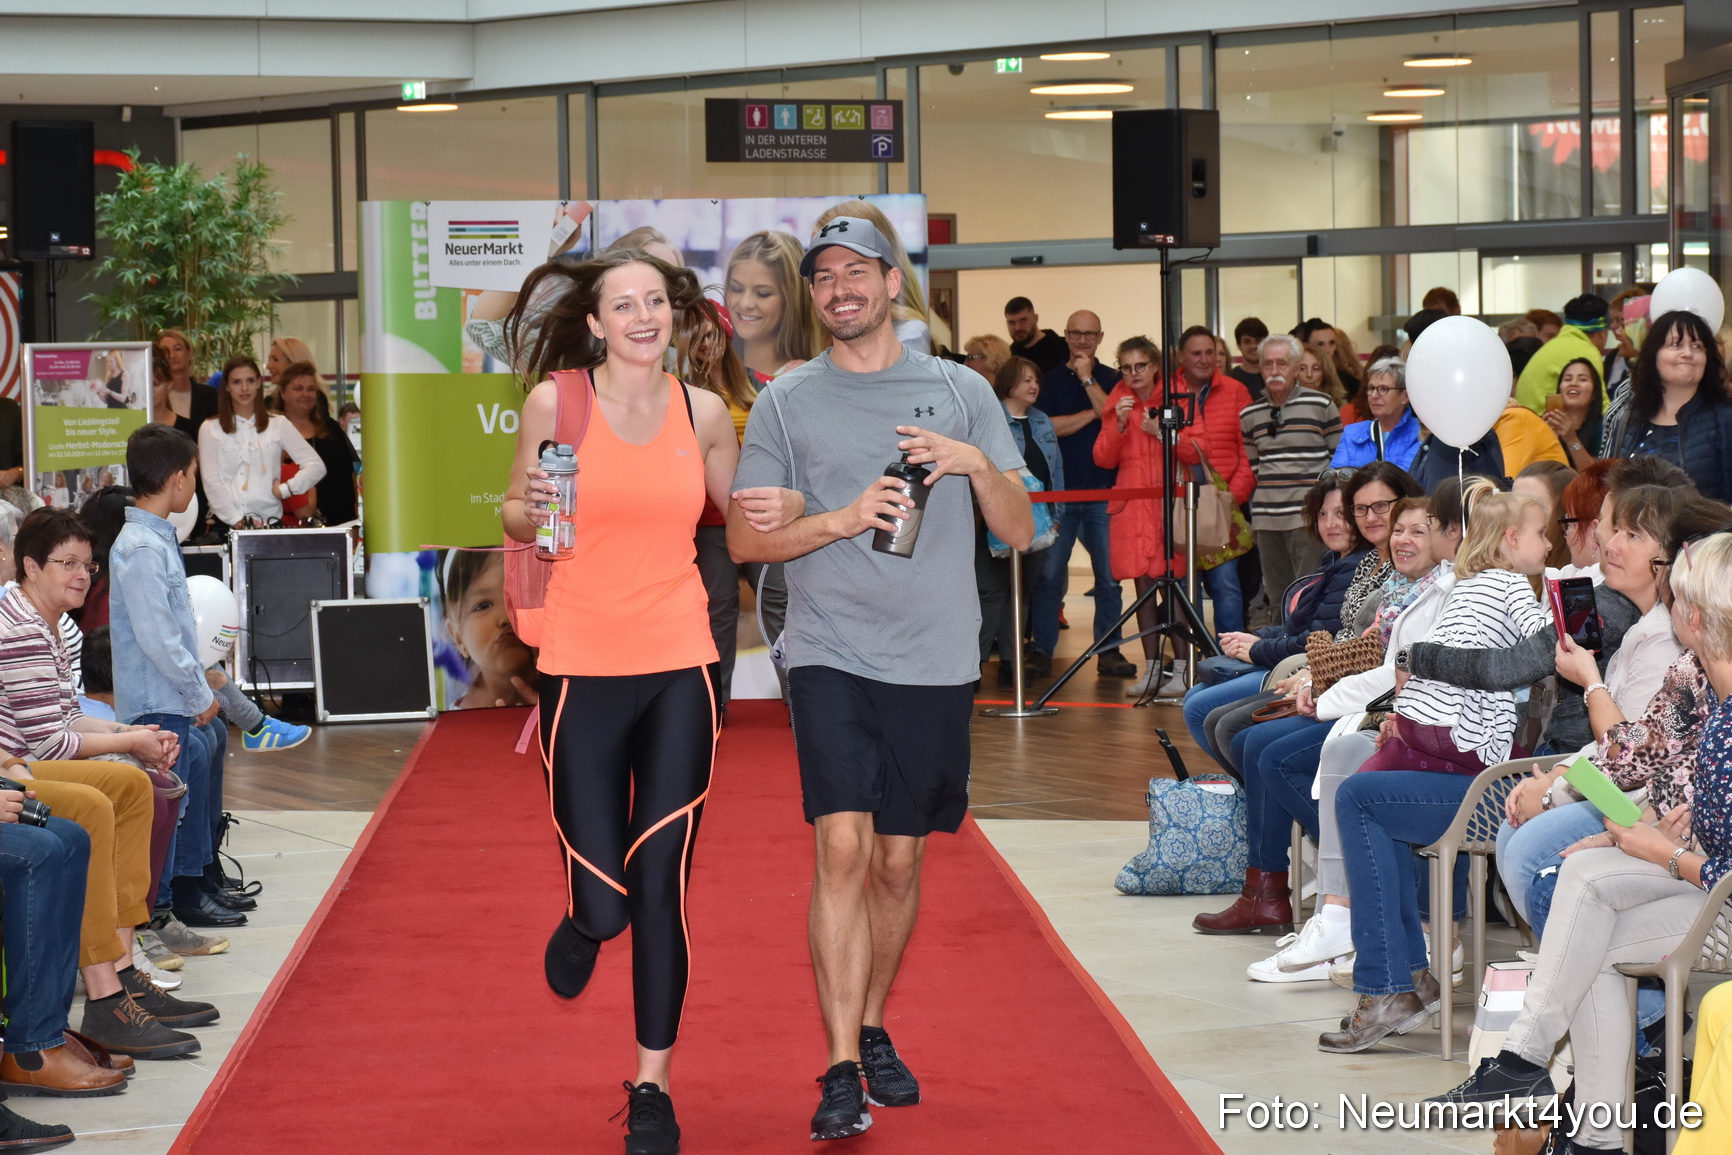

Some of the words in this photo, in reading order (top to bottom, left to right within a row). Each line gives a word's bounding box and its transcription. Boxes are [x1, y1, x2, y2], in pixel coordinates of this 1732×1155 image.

[745, 135, 755, 145] IN
[757, 135, 775, 145] DER
[779, 135, 827, 145] UNTEREN
[745, 148, 827, 159] LADENSTRASSE
[878, 142, 888, 157] P
[445, 242, 524, 255] NeuerMarkt
[63, 418, 77, 426] Von
[78, 417, 120, 426] Lieblingsteil
[477, 403, 519, 434] Vo
[65, 428, 76, 436] bis
[98, 427, 118, 436] Style.
[66, 441, 128, 449] Herbst-Modensch
[470, 493, 482, 504] Im
[483, 492, 505, 503] Stad
[211, 636, 232, 648] Neue
